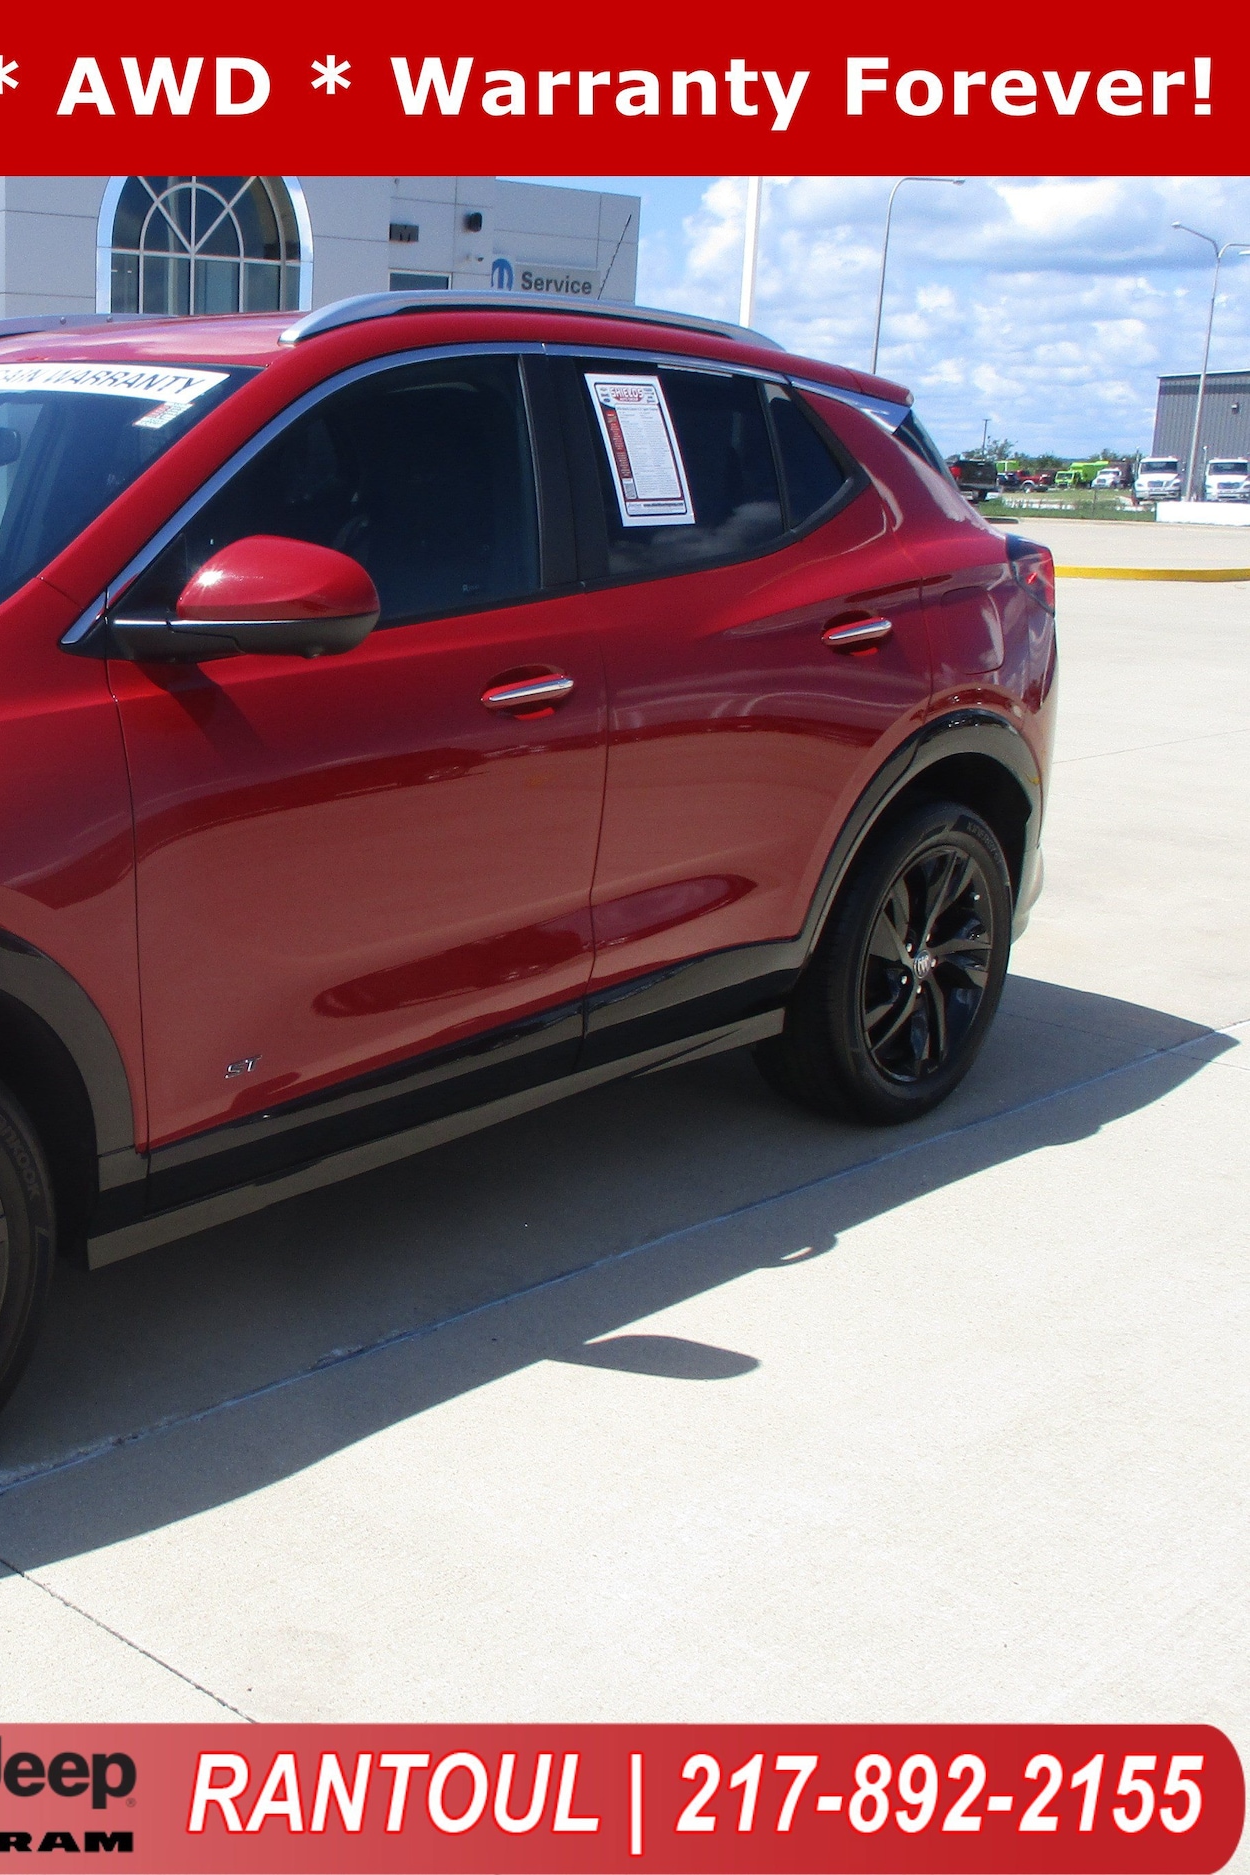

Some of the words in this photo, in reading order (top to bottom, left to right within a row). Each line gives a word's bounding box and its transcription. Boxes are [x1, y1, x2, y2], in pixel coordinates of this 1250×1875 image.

[520, 270, 593, 295] Service
[43, 369, 206, 394] WARRANTY
[224, 1054, 263, 1079] ST
